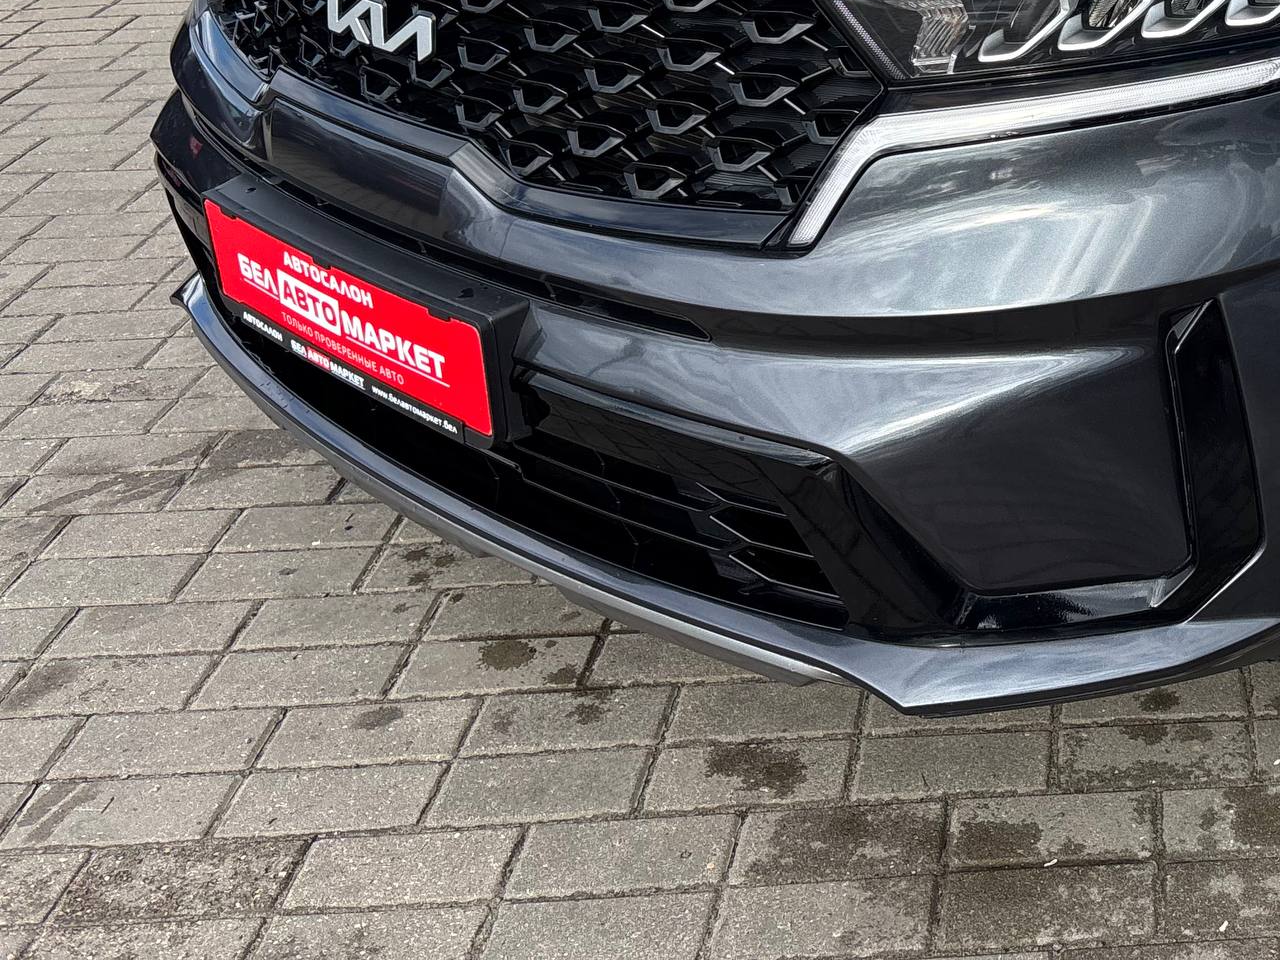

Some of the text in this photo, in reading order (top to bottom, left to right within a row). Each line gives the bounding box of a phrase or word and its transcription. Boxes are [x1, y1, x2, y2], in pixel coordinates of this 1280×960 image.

[283, 251, 374, 309] АВТОСАЛОН
[243, 310, 283, 342] АВТОСАЛОН
[281, 311, 405, 386] ТОЛЬКО ПРОВЕРЕННЫЕ АВТО
